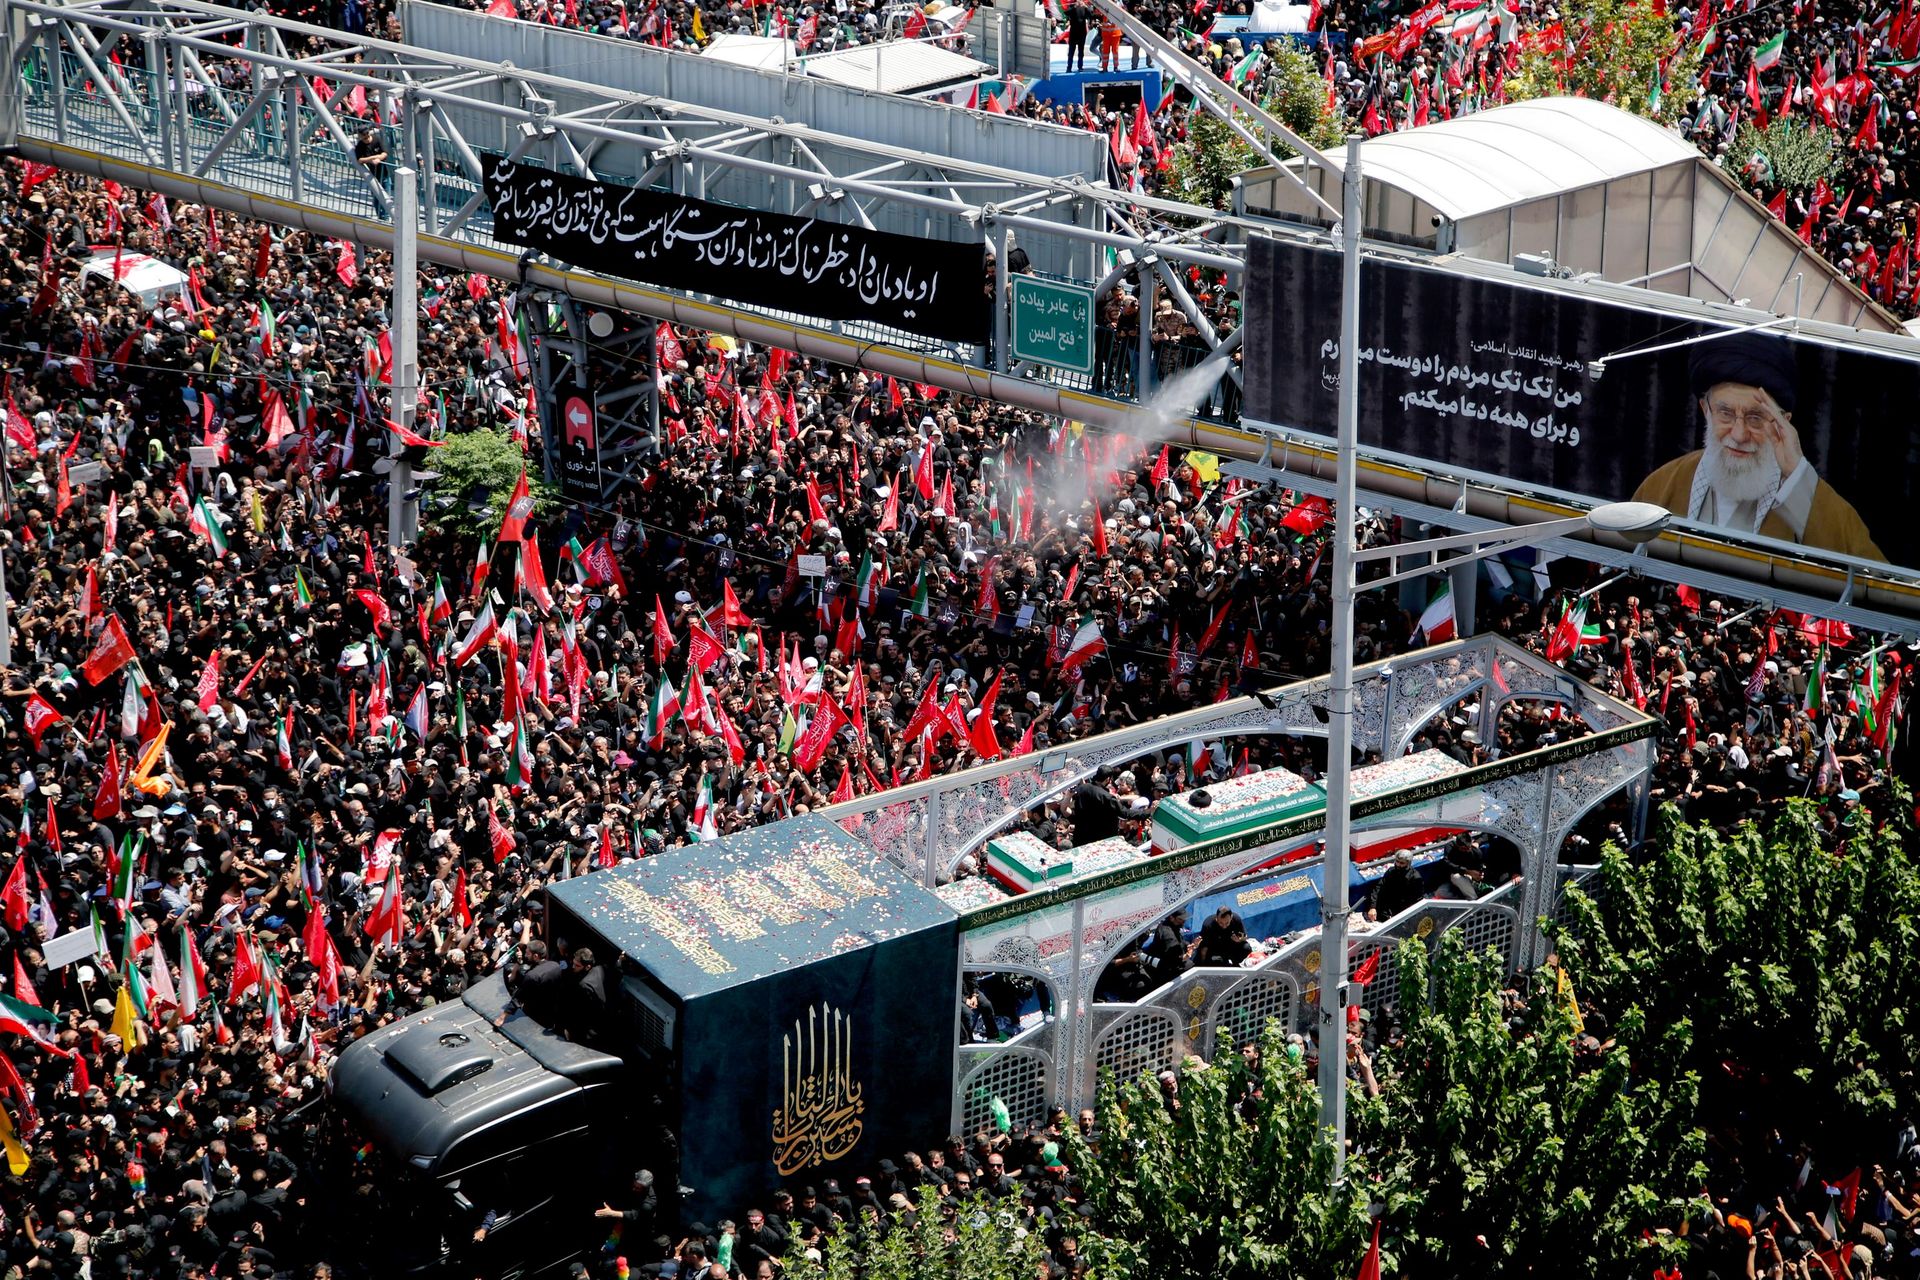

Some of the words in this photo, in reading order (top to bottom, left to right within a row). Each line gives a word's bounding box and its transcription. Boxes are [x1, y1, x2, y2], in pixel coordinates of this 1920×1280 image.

[526, 178, 554, 230] قعر
[556, 186, 569, 213] را
[609, 188, 636, 227] که
[513, 188, 537, 239] دریا
[541, 215, 553, 241] به
[707, 217, 748, 266] آن
[756, 233, 779, 269] از
[859, 263, 917, 319] یادمان
[915, 271, 939, 305] او
[1020, 292, 1044, 314] پیاده
[1047, 298, 1069, 315] عابر
[1029, 326, 1056, 343] المبین
[1058, 331, 1075, 351] فتح
[1469, 340, 1507, 355] اسلامی:
[1507, 345, 1538, 361] انقلاب
[1376, 347, 1433, 378] دوست
[1433, 354, 1446, 383] را
[1537, 351, 1563, 370] شهید
[1564, 354, 1585, 374] رهبر
[1446, 363, 1490, 391] مردم
[1522, 376, 1554, 400] تک
[1459, 395, 1489, 421] دعا
[1553, 386, 1583, 409] من
[1489, 410, 1530, 431] همه
[1530, 413, 1568, 443] برای
[1568, 426, 1581, 448] و
[566, 461, 584, 471] خوری
[585, 461, 596, 474] آب
